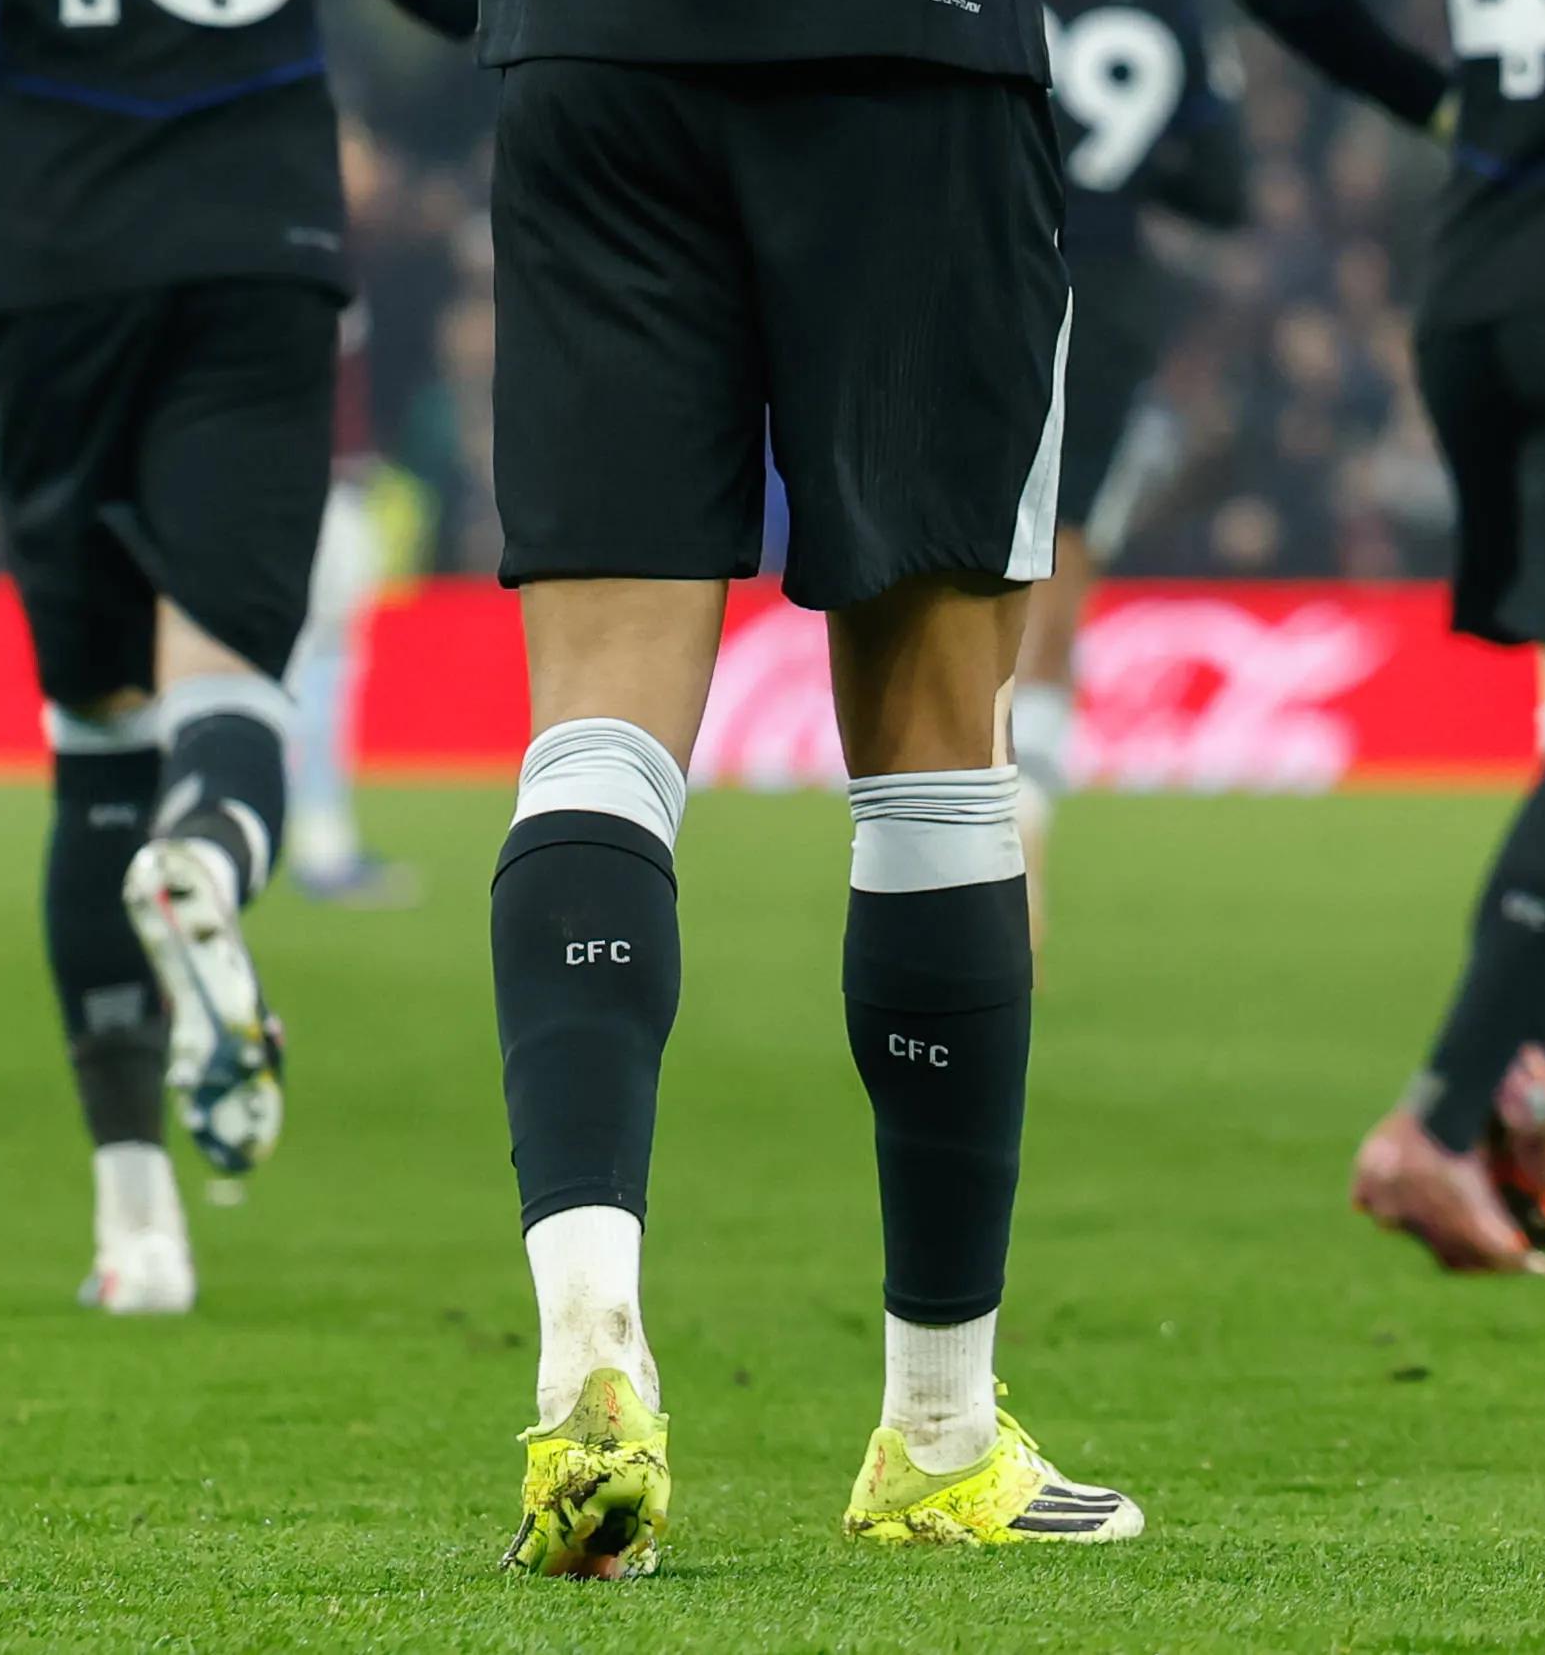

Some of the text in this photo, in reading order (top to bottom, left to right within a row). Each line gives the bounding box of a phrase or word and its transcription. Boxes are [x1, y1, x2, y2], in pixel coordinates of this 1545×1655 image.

[1042, 3, 1189, 193] 9
[565, 939, 632, 966] CFC
[888, 1033, 950, 1068] CFC
